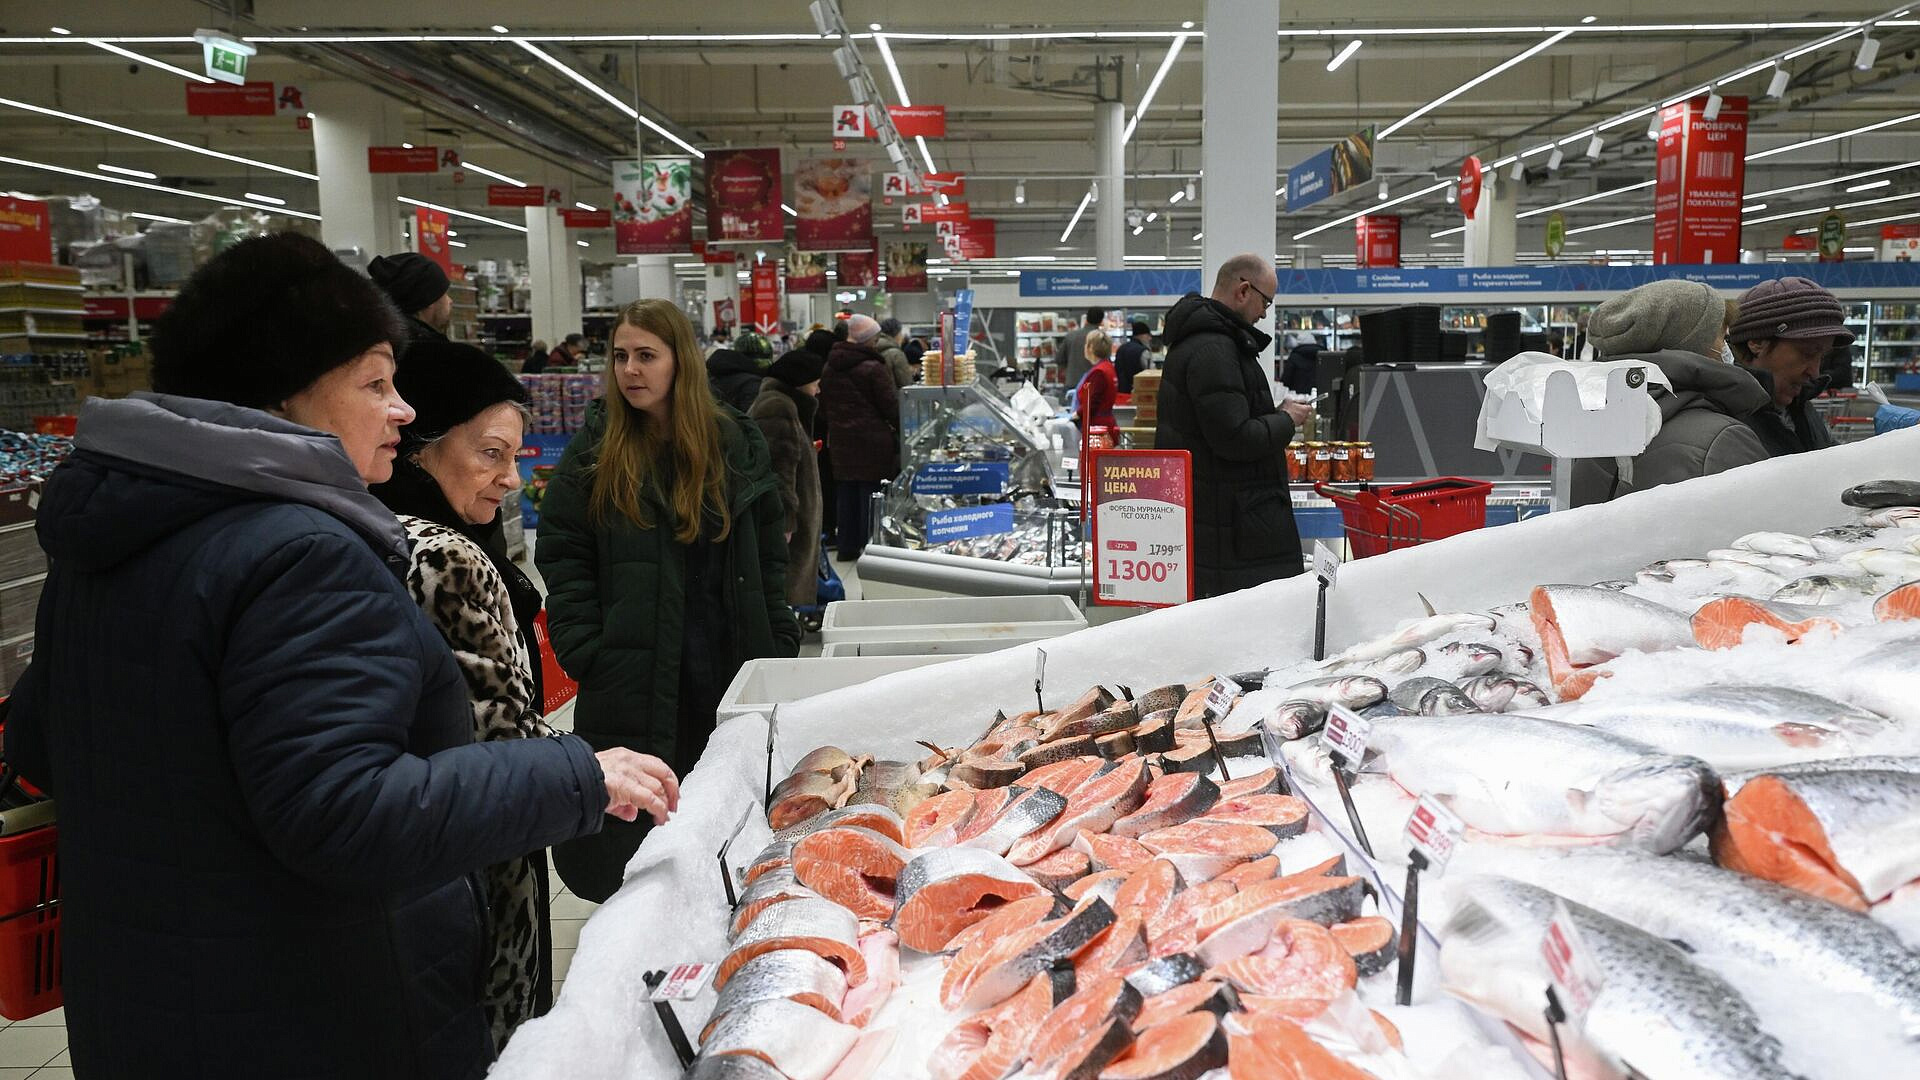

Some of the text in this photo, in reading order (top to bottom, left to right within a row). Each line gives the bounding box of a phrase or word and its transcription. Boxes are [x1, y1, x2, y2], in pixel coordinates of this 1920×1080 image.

[1692, 121, 1743, 131] ПРОВЕРКА
[1707, 132, 1727, 142] ЦЕН
[1689, 190, 1737, 198] УВАЖАЕМЫЕ
[1090, 284, 1109, 292] рыба
[1104, 466, 1161, 480] УДАРНАЯ
[1104, 482, 1137, 495] ЦЕНА
[1109, 505, 1175, 514] ФОРЕЛЬ МУРМАНСК
[931, 510, 994, 525] Рыба холодного
[932, 525, 968, 535] копчения
